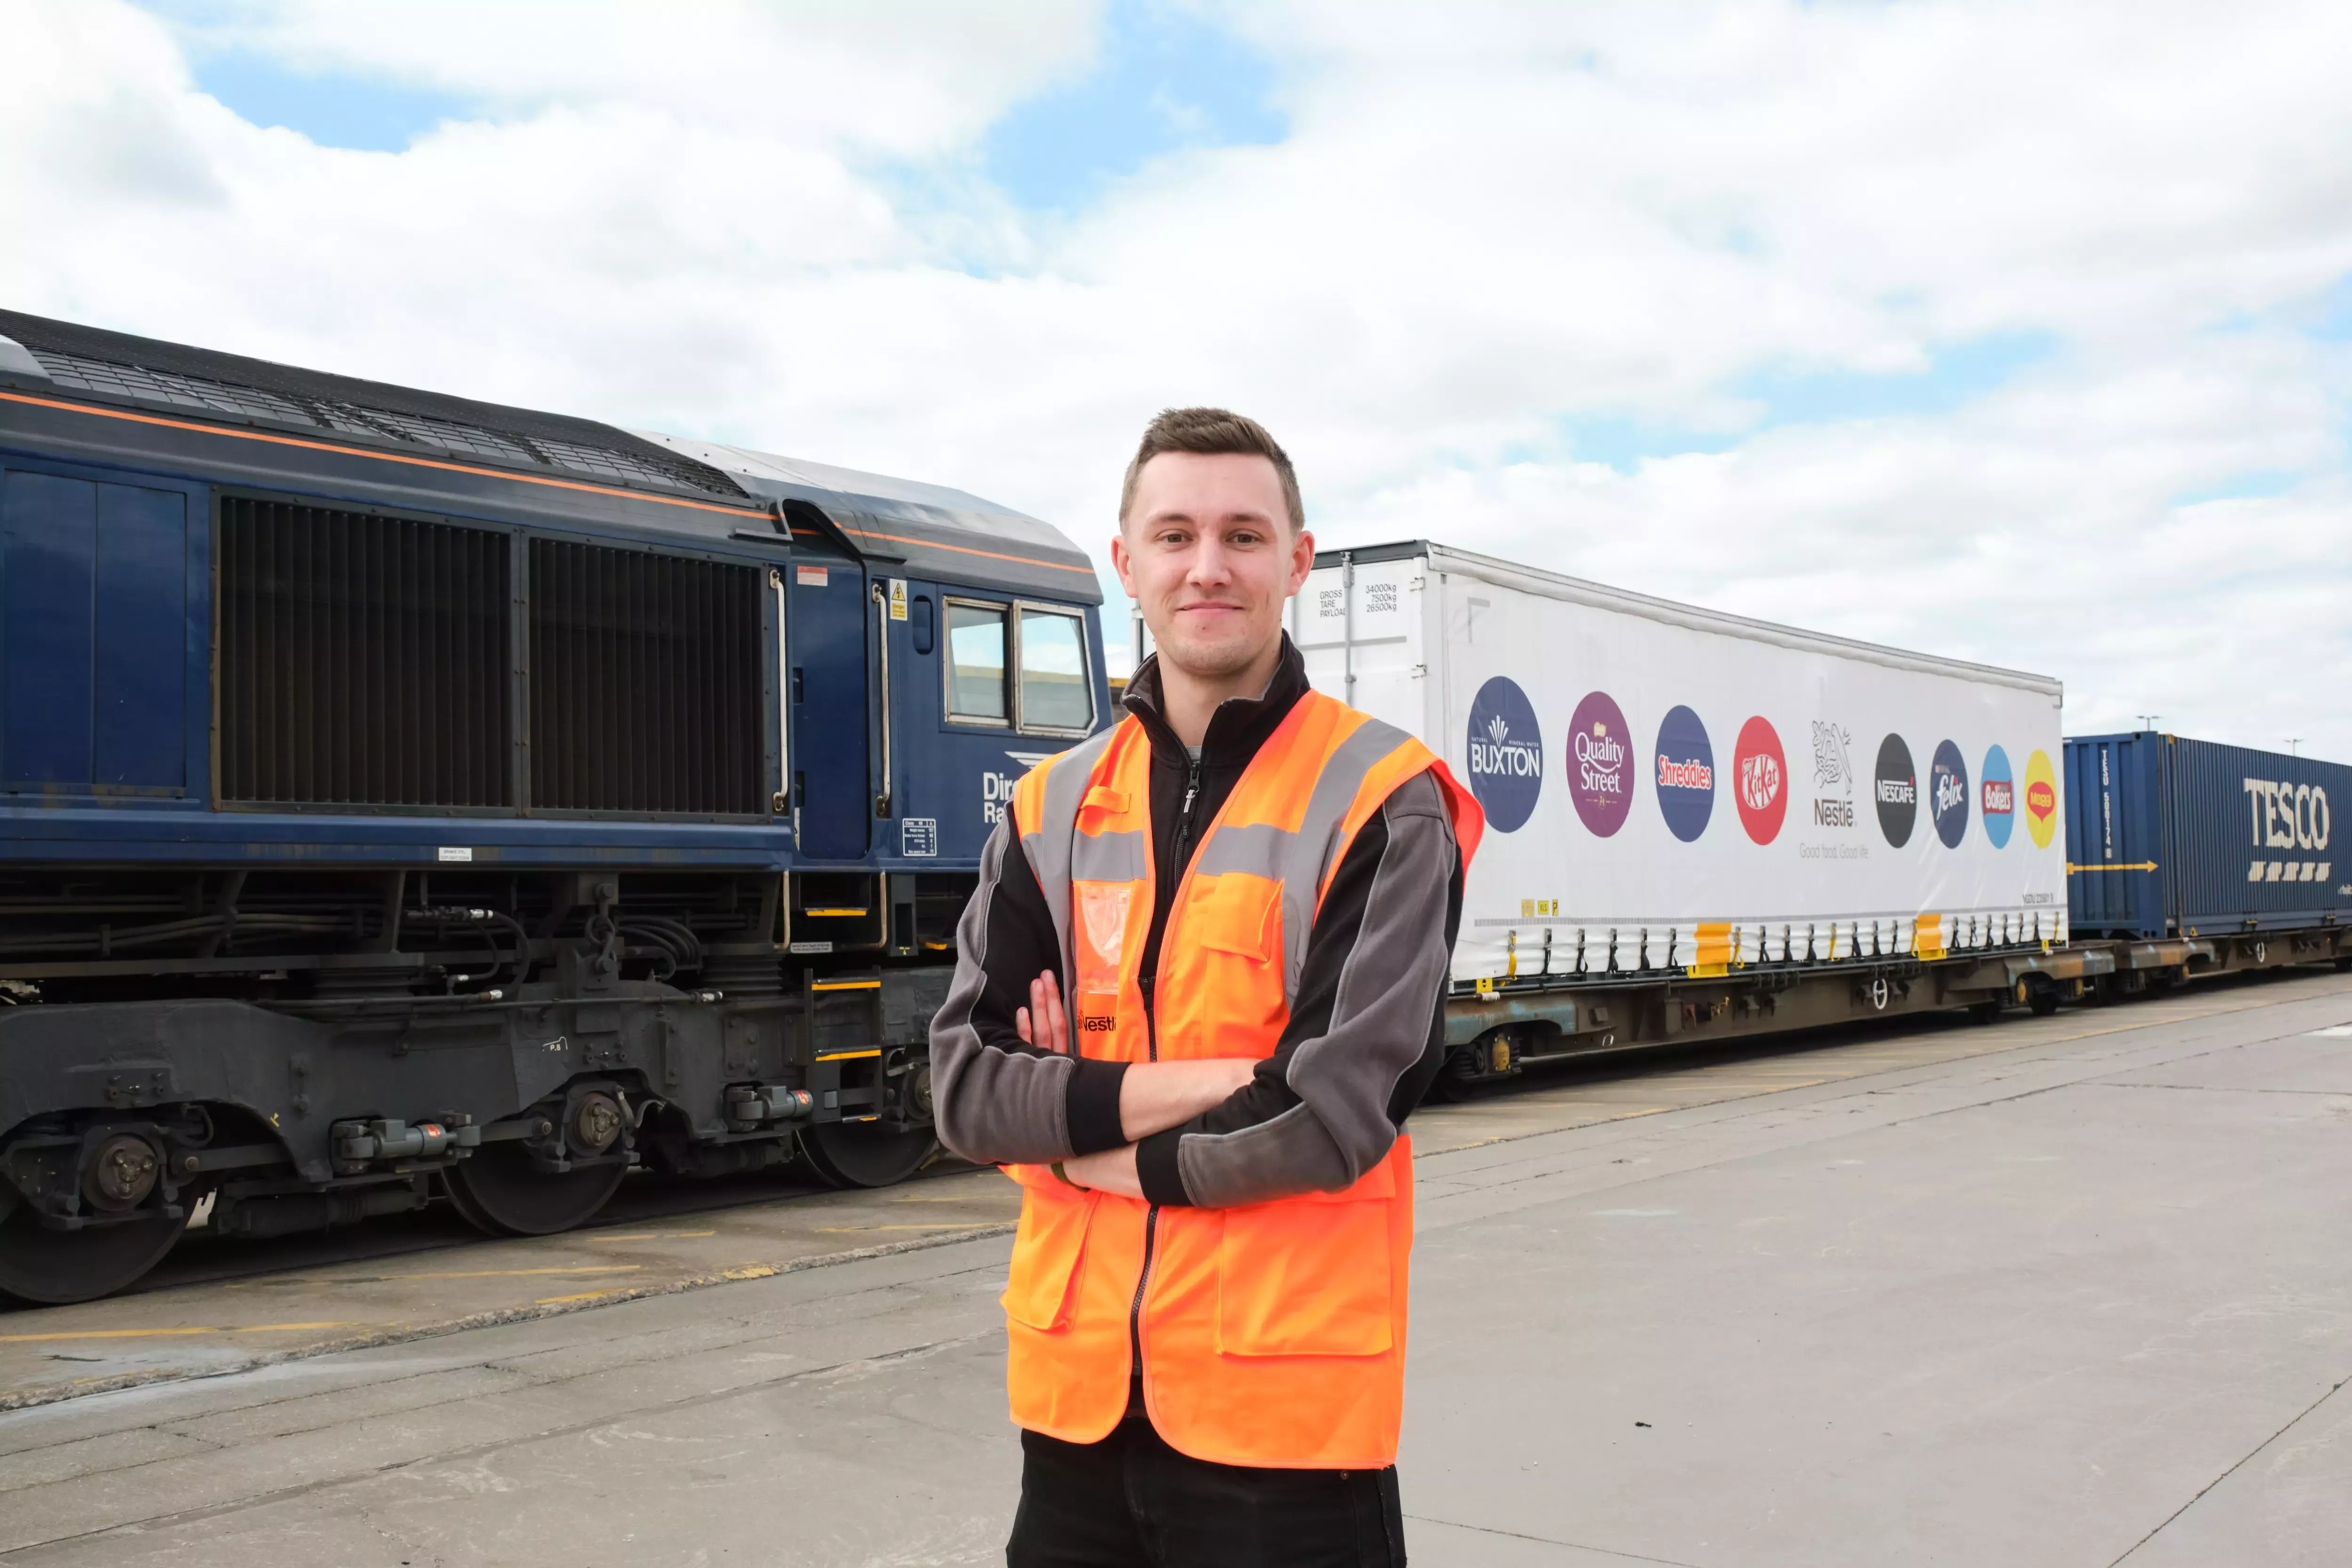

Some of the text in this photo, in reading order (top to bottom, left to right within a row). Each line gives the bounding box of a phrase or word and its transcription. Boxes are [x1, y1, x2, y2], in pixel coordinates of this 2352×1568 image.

[1320, 583, 1397, 599] GROSS 34000kg
[1320, 594, 1397, 609] TARE 7500kg
[1367, 603, 1397, 613] 26500kg
[1471, 743, 1540, 777] BUXTON
[1575, 732, 1625, 773] Quality
[1581, 763, 1621, 793] Street
[1659, 755, 1711, 789] Shreddies
[1747, 756, 1777, 807] KitKat
[1877, 777, 1914, 804] NESCAFÉ
[1985, 784, 2011, 811] Bakers
[2030, 792, 2052, 808] Maggi
[1814, 798, 1853, 827] Nestlé
[2244, 777, 2330, 851] TESCO
[1800, 842, 1820, 859] Good
[1082, 1016, 1116, 1031] Nestl
